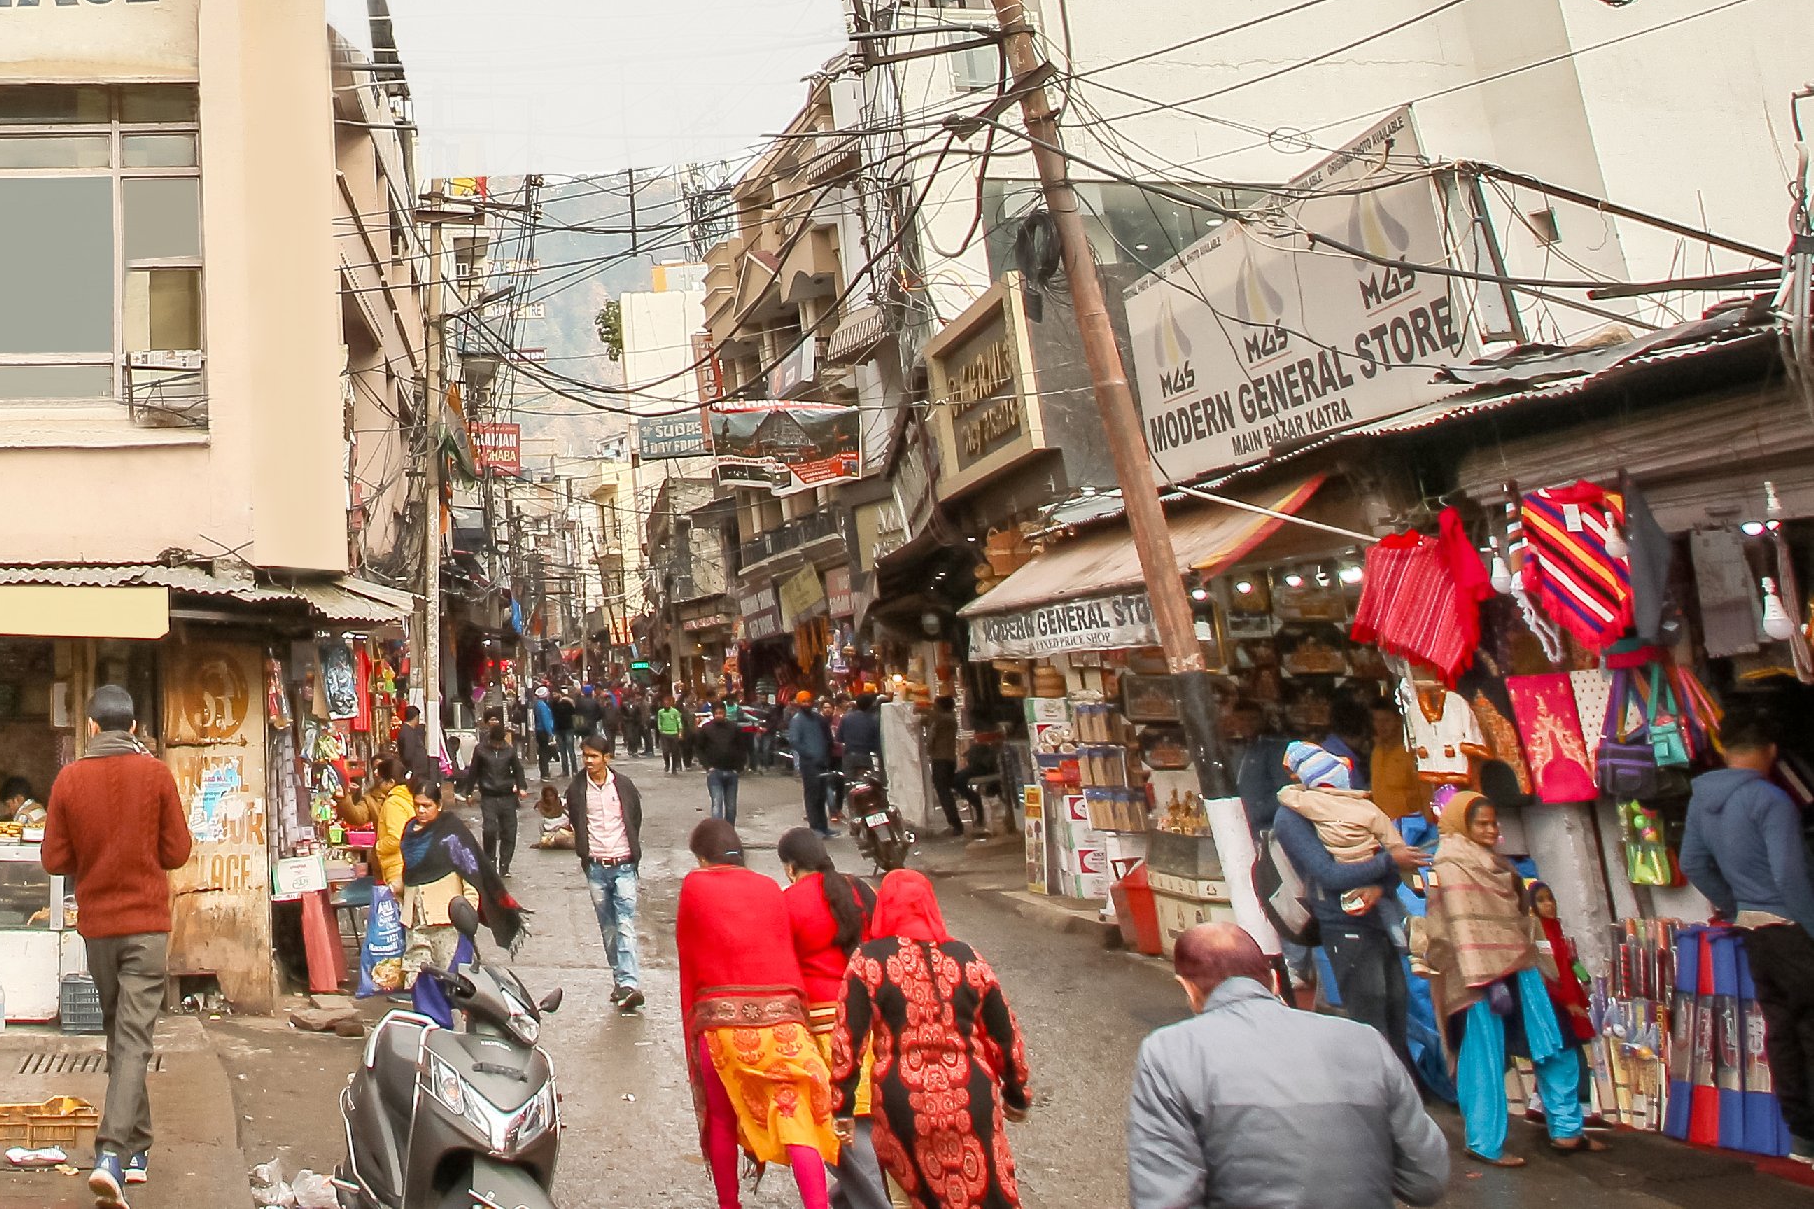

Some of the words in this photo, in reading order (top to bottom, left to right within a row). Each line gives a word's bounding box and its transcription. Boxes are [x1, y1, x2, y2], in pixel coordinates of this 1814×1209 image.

[1149, 390, 1236, 454] MODERN
[1238, 345, 1354, 424] GENERAL
[1354, 295, 1461, 379] STORE
[1159, 359, 1195, 398] MGS
[655, 420, 703, 438] SUBAS
[1231, 430, 1263, 457] MAIN
[1264, 415, 1306, 445] BAZAR
[1305, 397, 1354, 437] KATRA
[1037, 601, 1111, 638] GENERAL
[1112, 595, 1152, 627] STO
[1060, 634, 1086, 649] PRICE
[1086, 631, 1111, 645] SHOP
